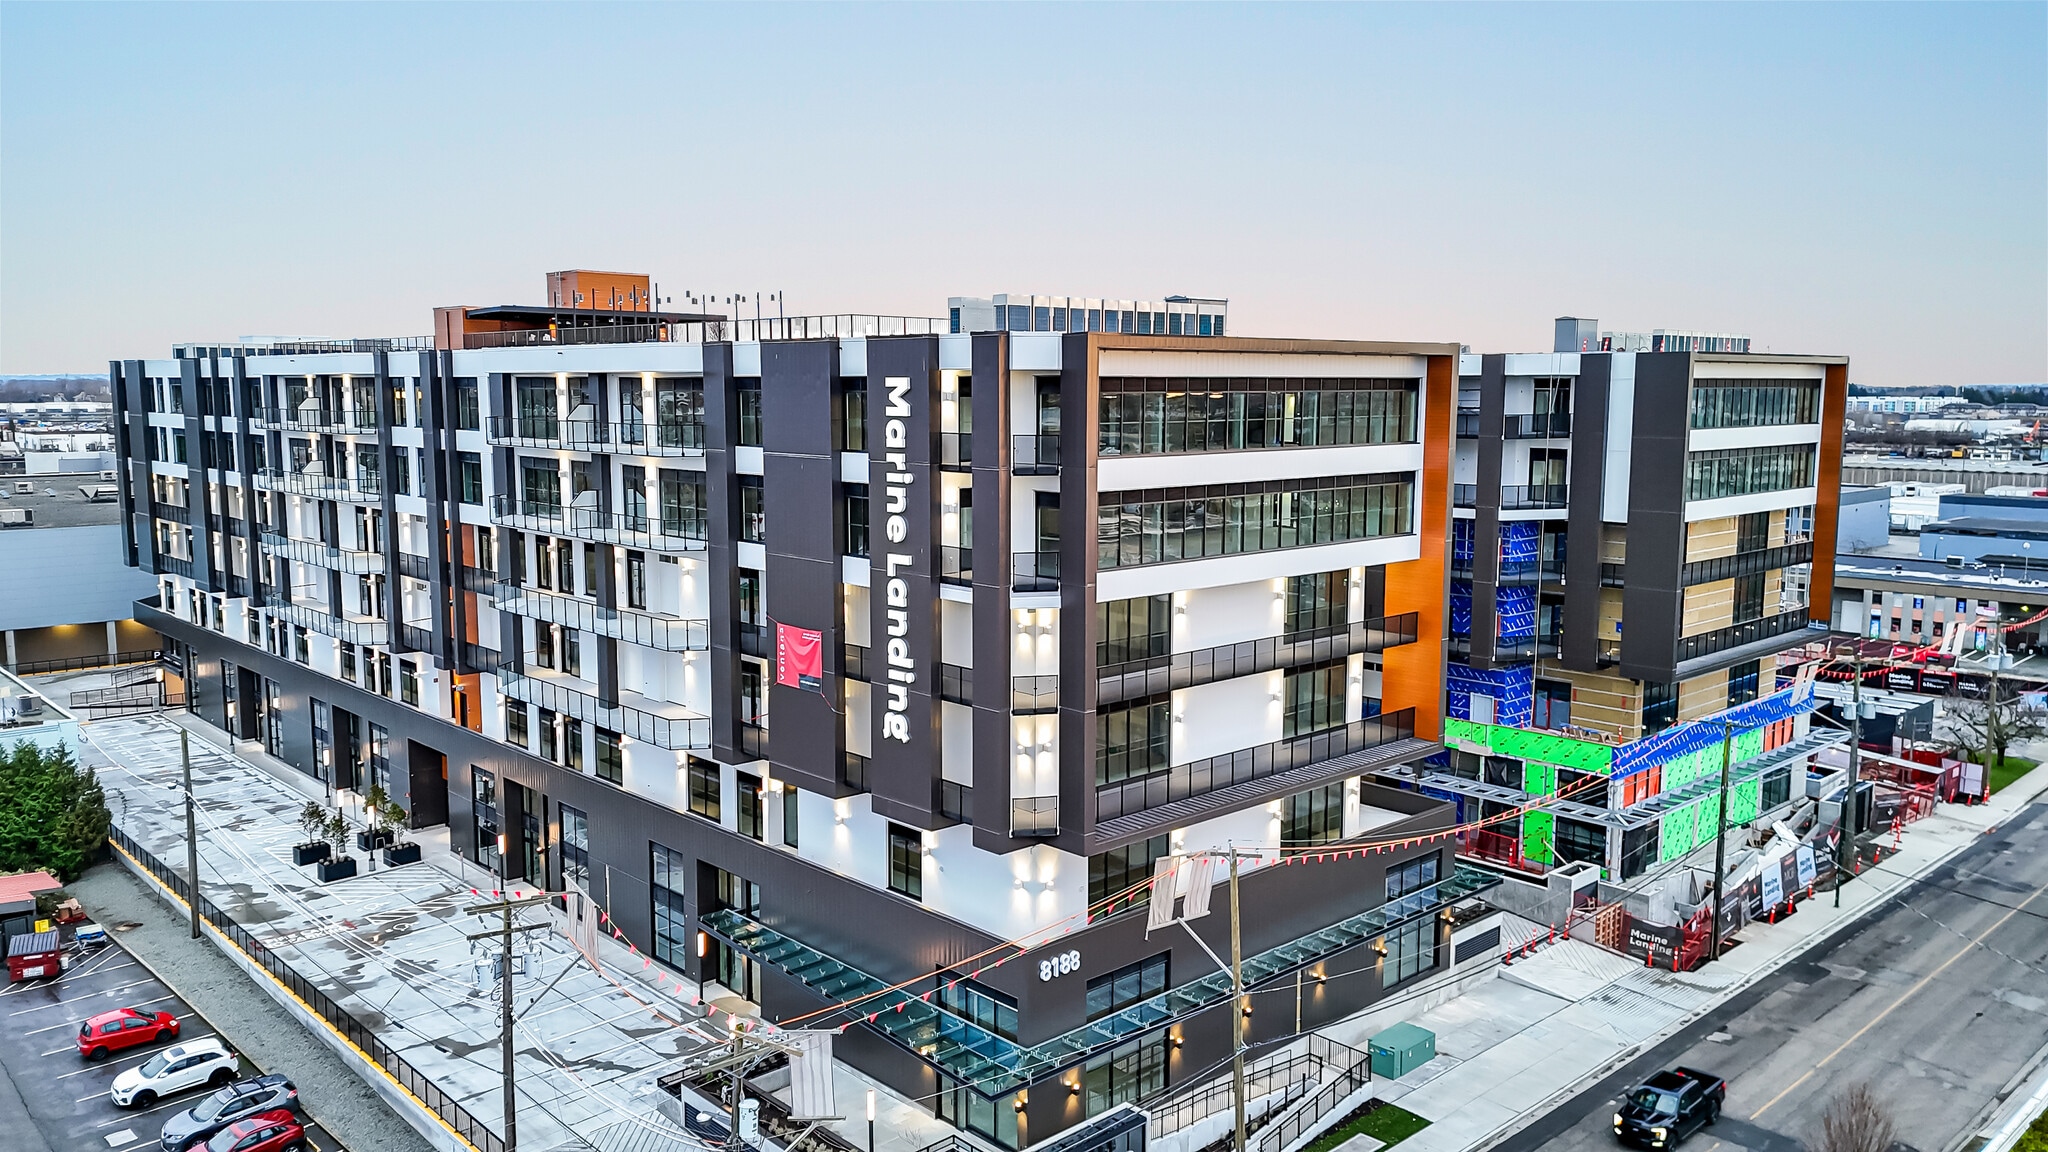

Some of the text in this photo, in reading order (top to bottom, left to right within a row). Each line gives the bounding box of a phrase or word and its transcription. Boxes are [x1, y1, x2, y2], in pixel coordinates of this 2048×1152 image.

[883, 376, 914, 744] Marine Landing
[153, 651, 161, 659] P
[1629, 936, 1673, 956] Landing
[1630, 928, 1668, 945] Marine
[1039, 950, 1081, 982] 8188
